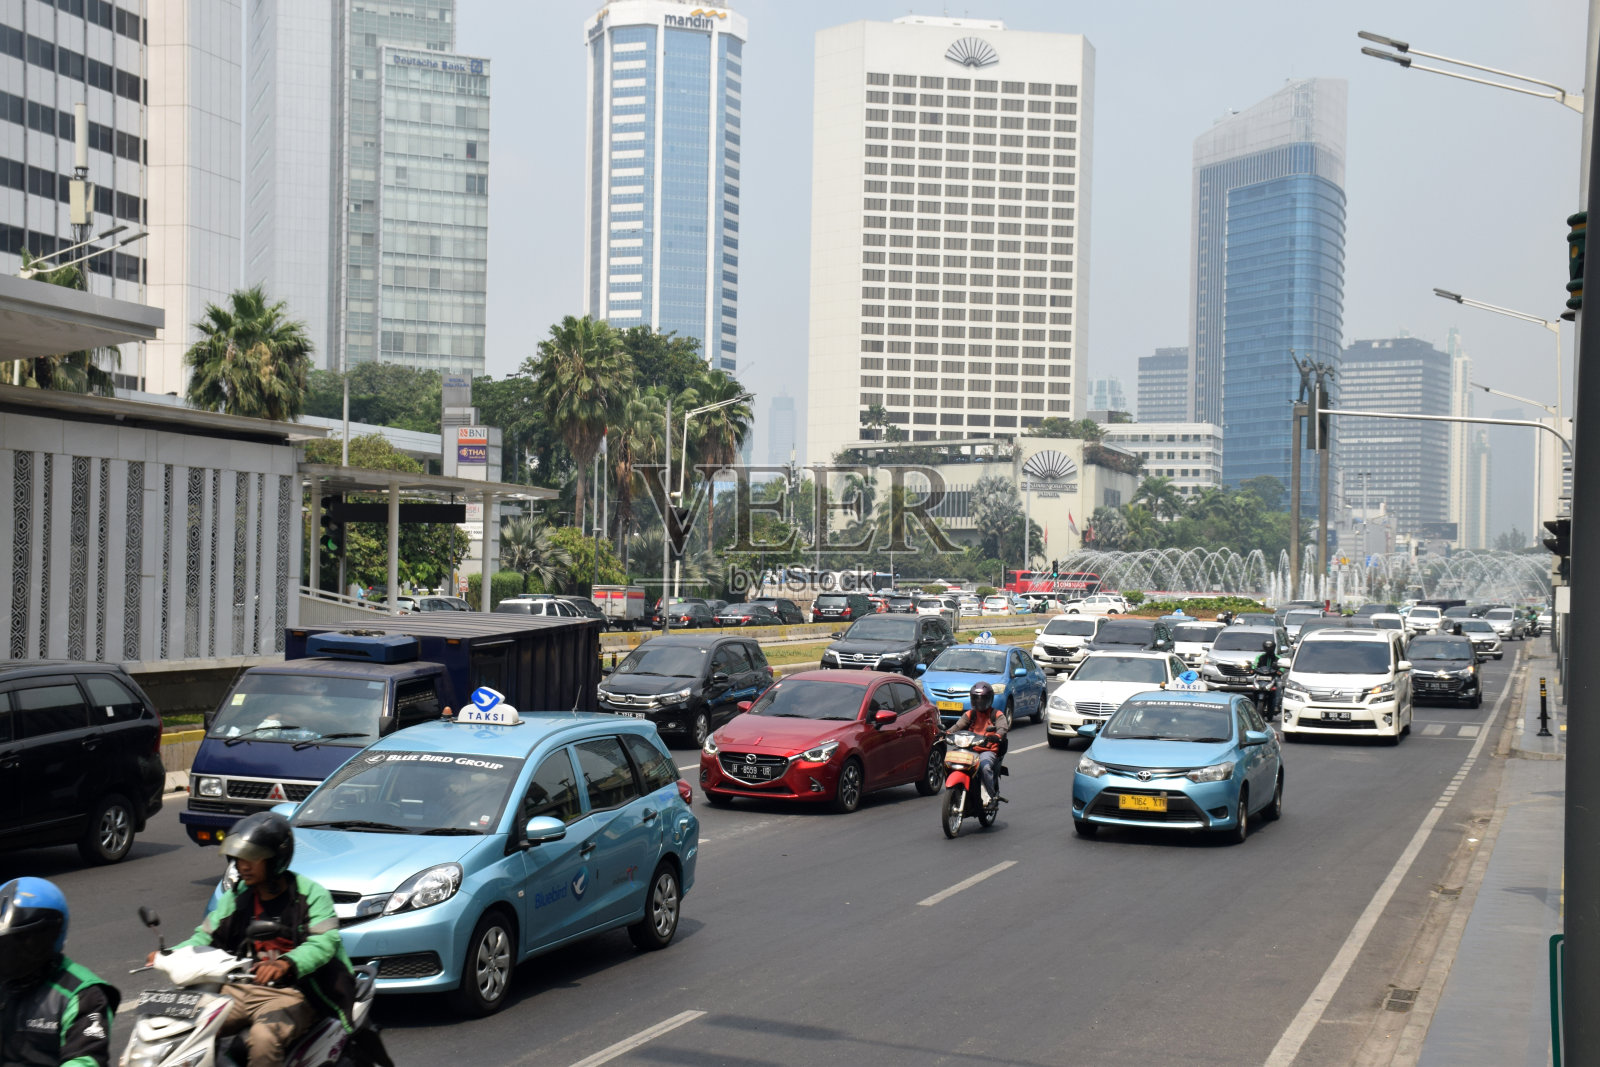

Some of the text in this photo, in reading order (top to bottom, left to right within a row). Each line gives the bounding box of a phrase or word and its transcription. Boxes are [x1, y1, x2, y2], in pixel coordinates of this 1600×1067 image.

[664, 13, 714, 30] mandiri
[393, 54, 466, 72] Deutsche Bank
[469, 428, 486, 438] BNI
[468, 711, 505, 722] TAKSI
[386, 754, 504, 770] BLUE BIRD GROUP
[1121, 796, 1127, 805] B
[535, 882, 568, 910] Bluebird
